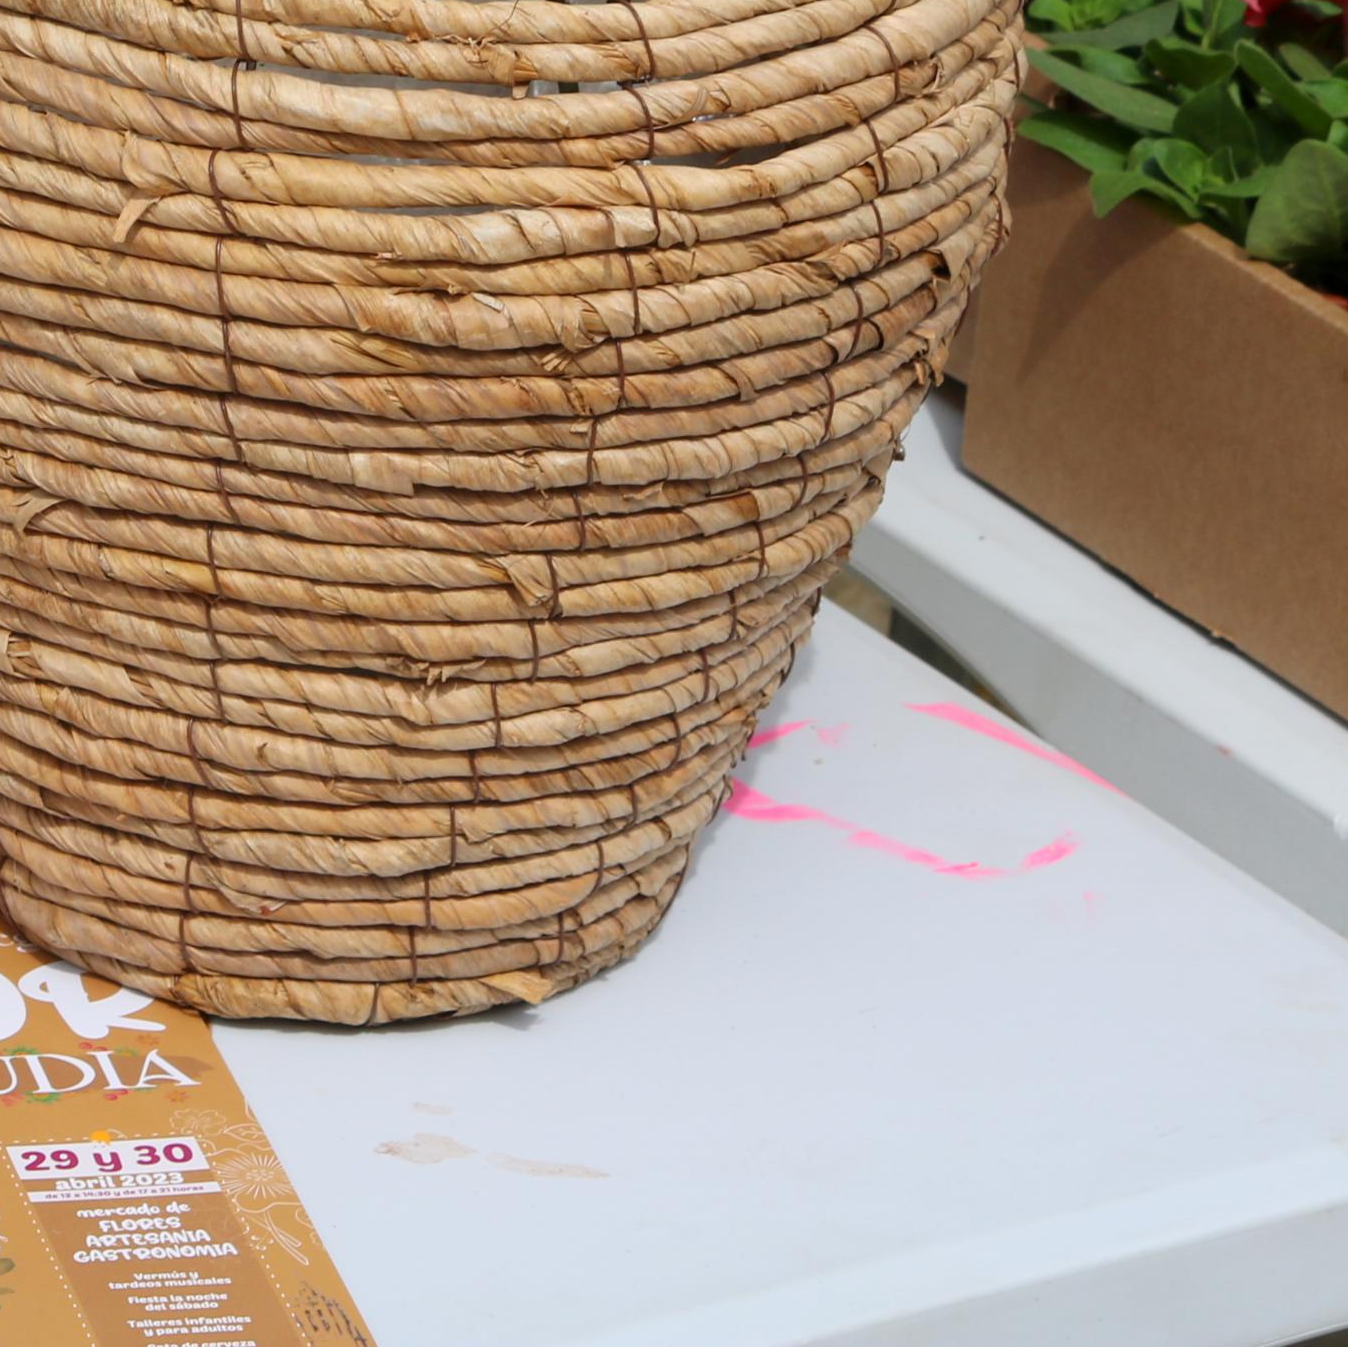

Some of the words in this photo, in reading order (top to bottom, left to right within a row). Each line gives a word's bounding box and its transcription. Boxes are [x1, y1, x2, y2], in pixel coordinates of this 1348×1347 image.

[21, 1149, 79, 1171] 29
[93, 1151, 123, 1172] y
[134, 1142, 193, 1165] 30
[56, 1175, 114, 1191] abril
[119, 1172, 185, 1188] 2023
[173, 1185, 204, 1193] horas
[77, 1203, 160, 1218] mercado
[166, 1201, 191, 1214] de
[99, 1217, 182, 1232] FLORES
[86, 1229, 211, 1248] ARTESANIA
[73, 1242, 239, 1263] GASTRONOMIA
[133, 1270, 187, 1281] Vermús
[189, 1272, 199, 1280] y
[109, 1281, 162, 1290] tardeos
[164, 1277, 232, 1288] musicales
[128, 1296, 168, 1304] Fiesta
[170, 1294, 183, 1302] la
[185, 1292, 228, 1302] noche
[145, 1303, 167, 1311] del
[169, 1300, 219, 1311] sábado
[127, 1319, 183, 1329] Talleres
[185, 1315, 252, 1326] infantiles
[144, 1329, 153, 1337] y
[156, 1326, 189, 1336] para
[192, 1324, 244, 1333] adultos
